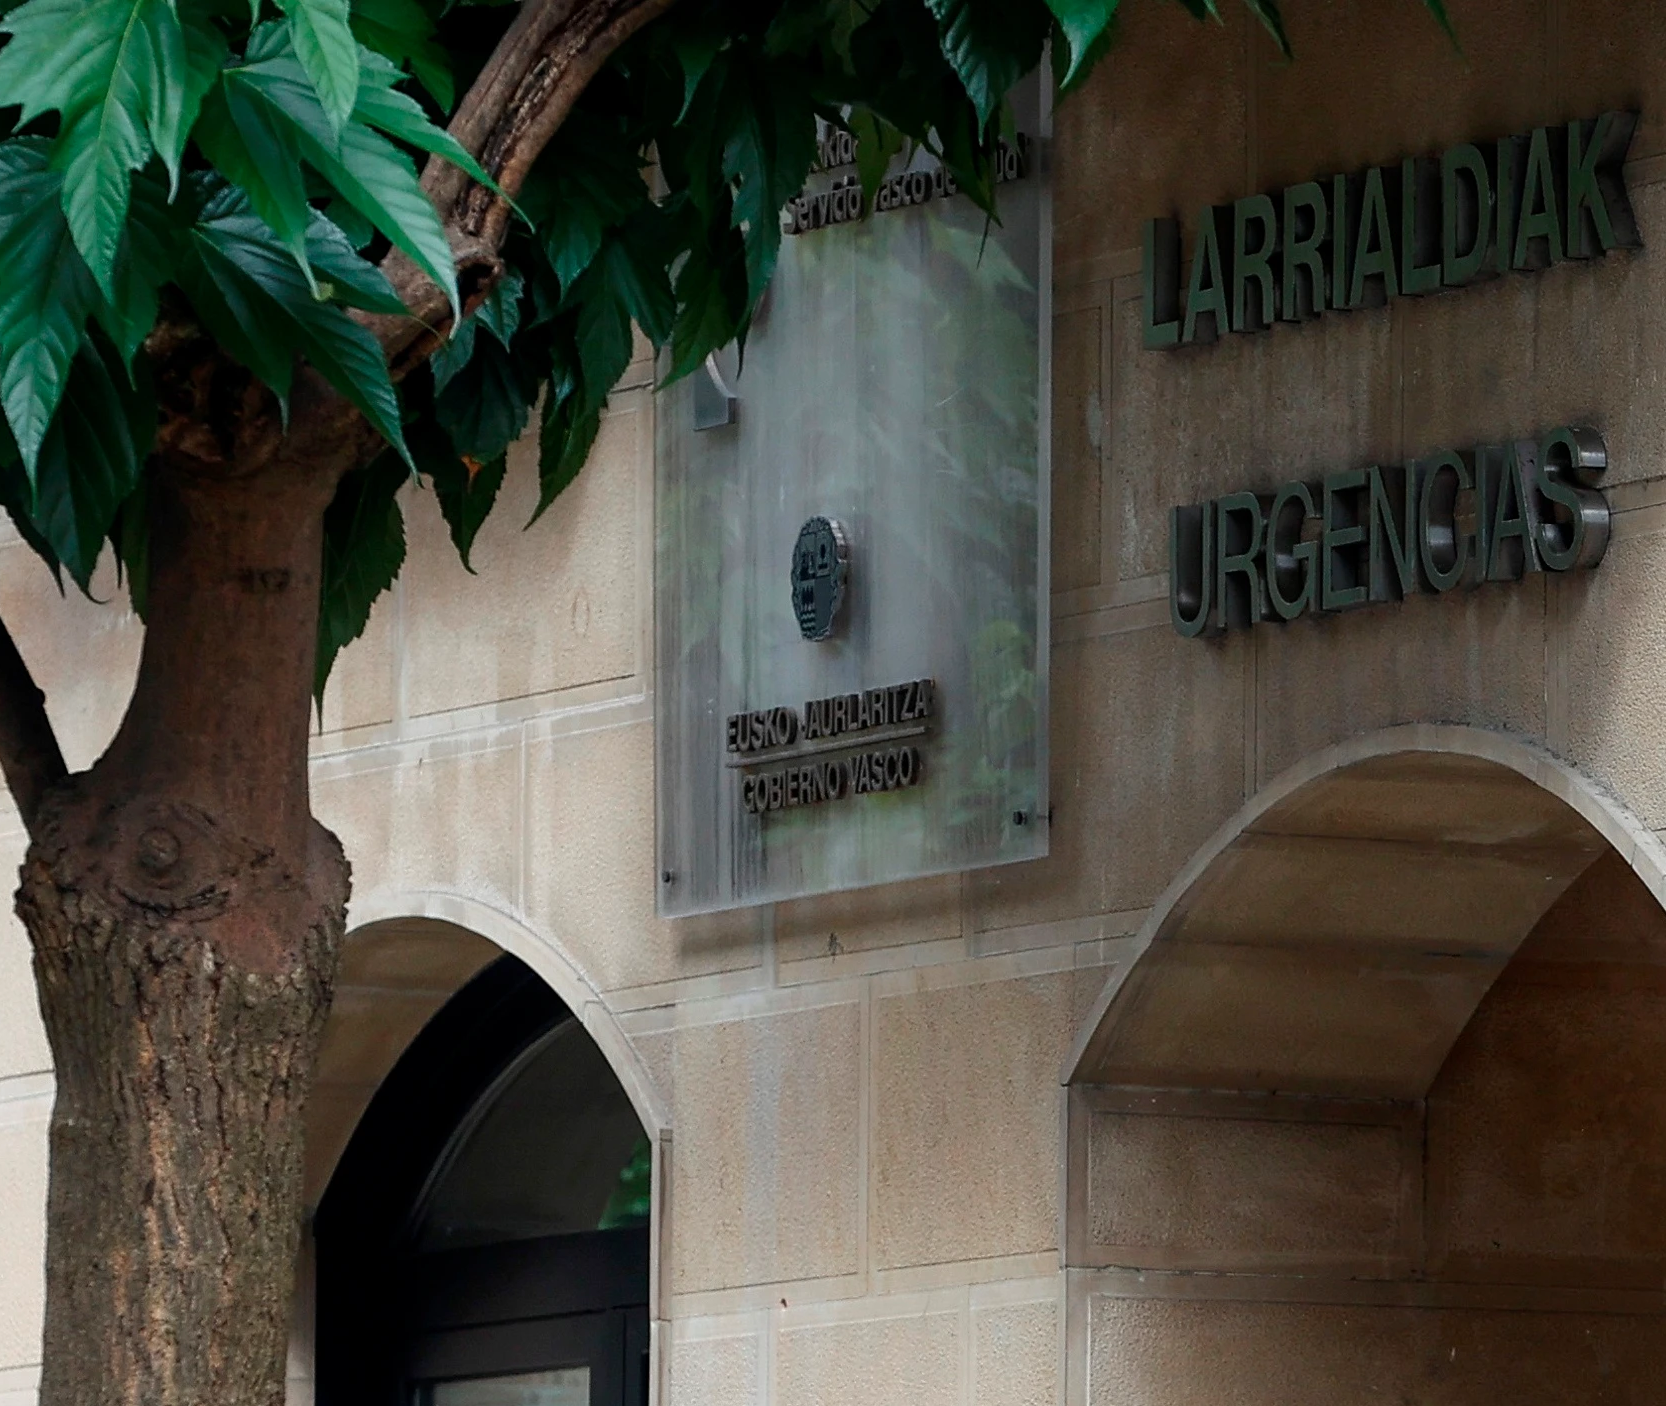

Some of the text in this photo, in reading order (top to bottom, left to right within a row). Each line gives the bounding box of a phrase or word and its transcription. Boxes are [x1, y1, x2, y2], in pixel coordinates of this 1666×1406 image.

[1143, 110, 1641, 350] LARRIALDIAK
[1169, 426, 1611, 638] URGENCIAS
[727, 706, 796, 752] EUSKO
[743, 747, 918, 814] GOBIERNO VASCO
